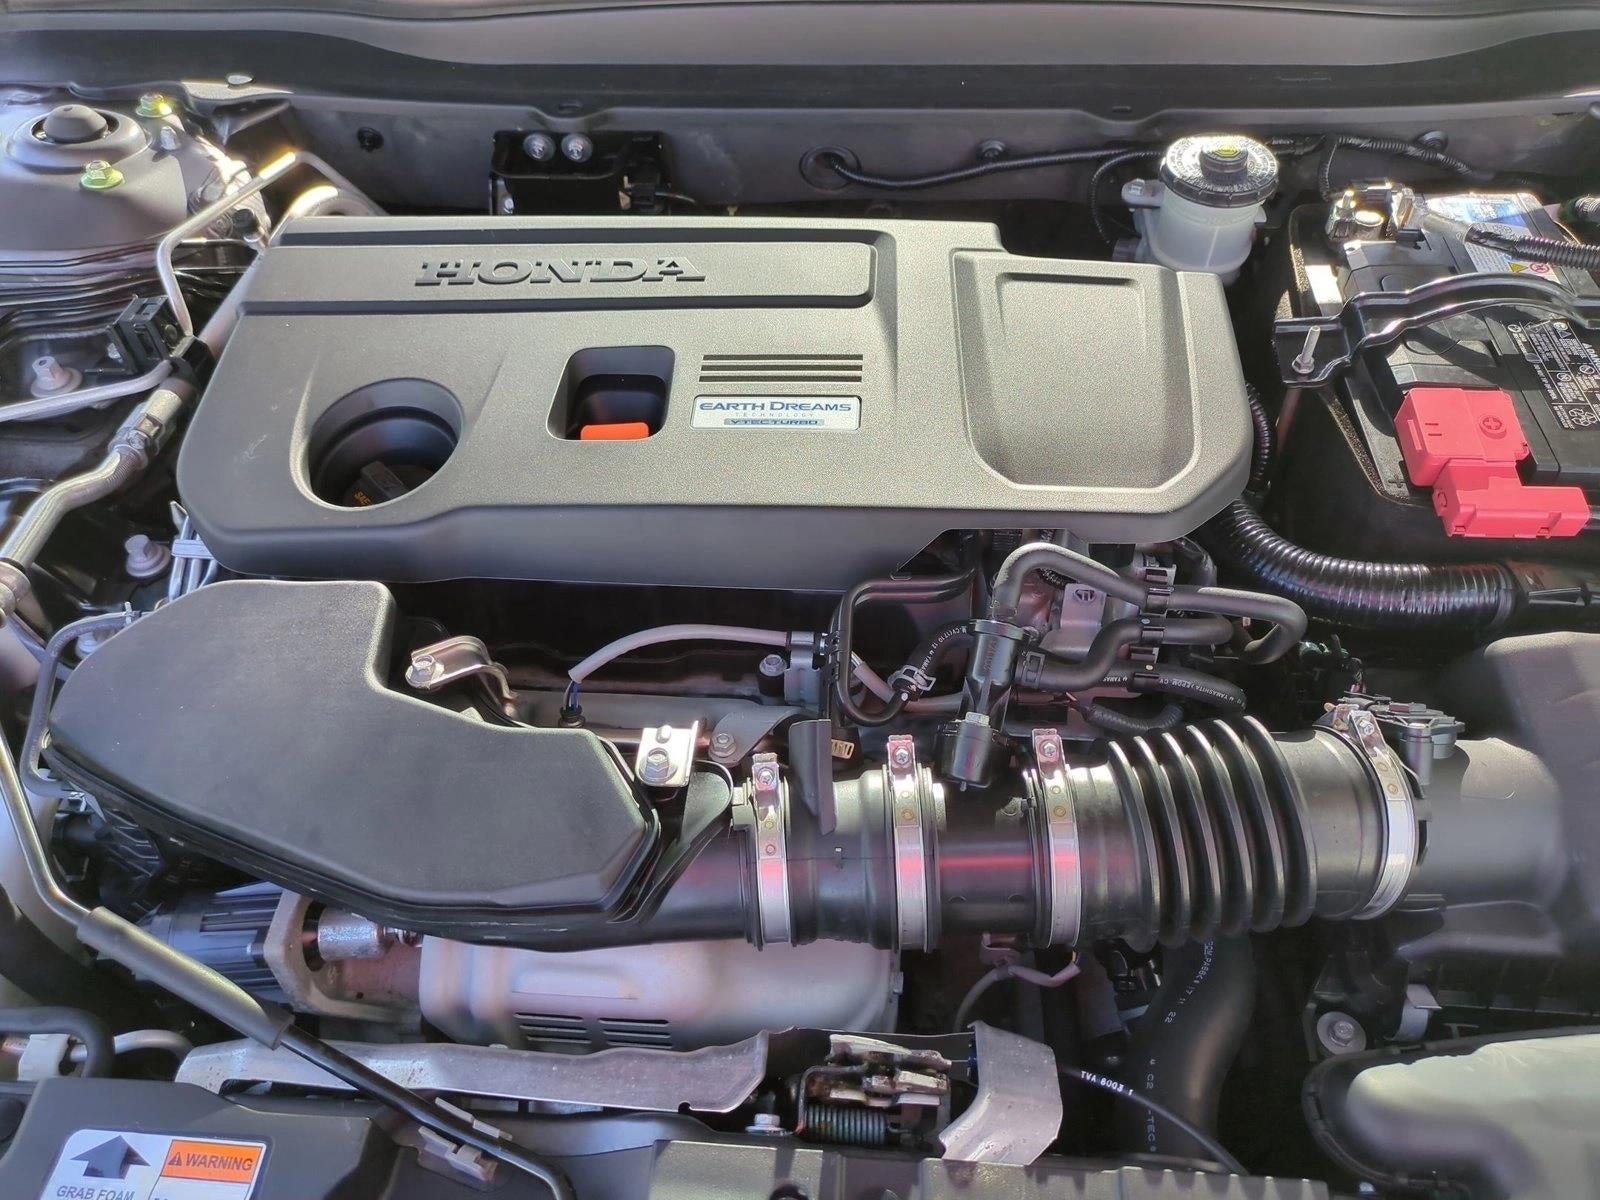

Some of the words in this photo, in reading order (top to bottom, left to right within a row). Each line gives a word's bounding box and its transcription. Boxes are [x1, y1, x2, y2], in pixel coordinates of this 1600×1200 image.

[414, 256, 706, 287] HONDA
[699, 402, 765, 411] EARTH
[769, 401, 852, 412] DREAMS
[1081, 1070, 1097, 1082] TVA
[185, 1154, 254, 1171] WARNING
[57, 1185, 95, 1200] GRAB
[97, 1189, 135, 1200] FOAM
